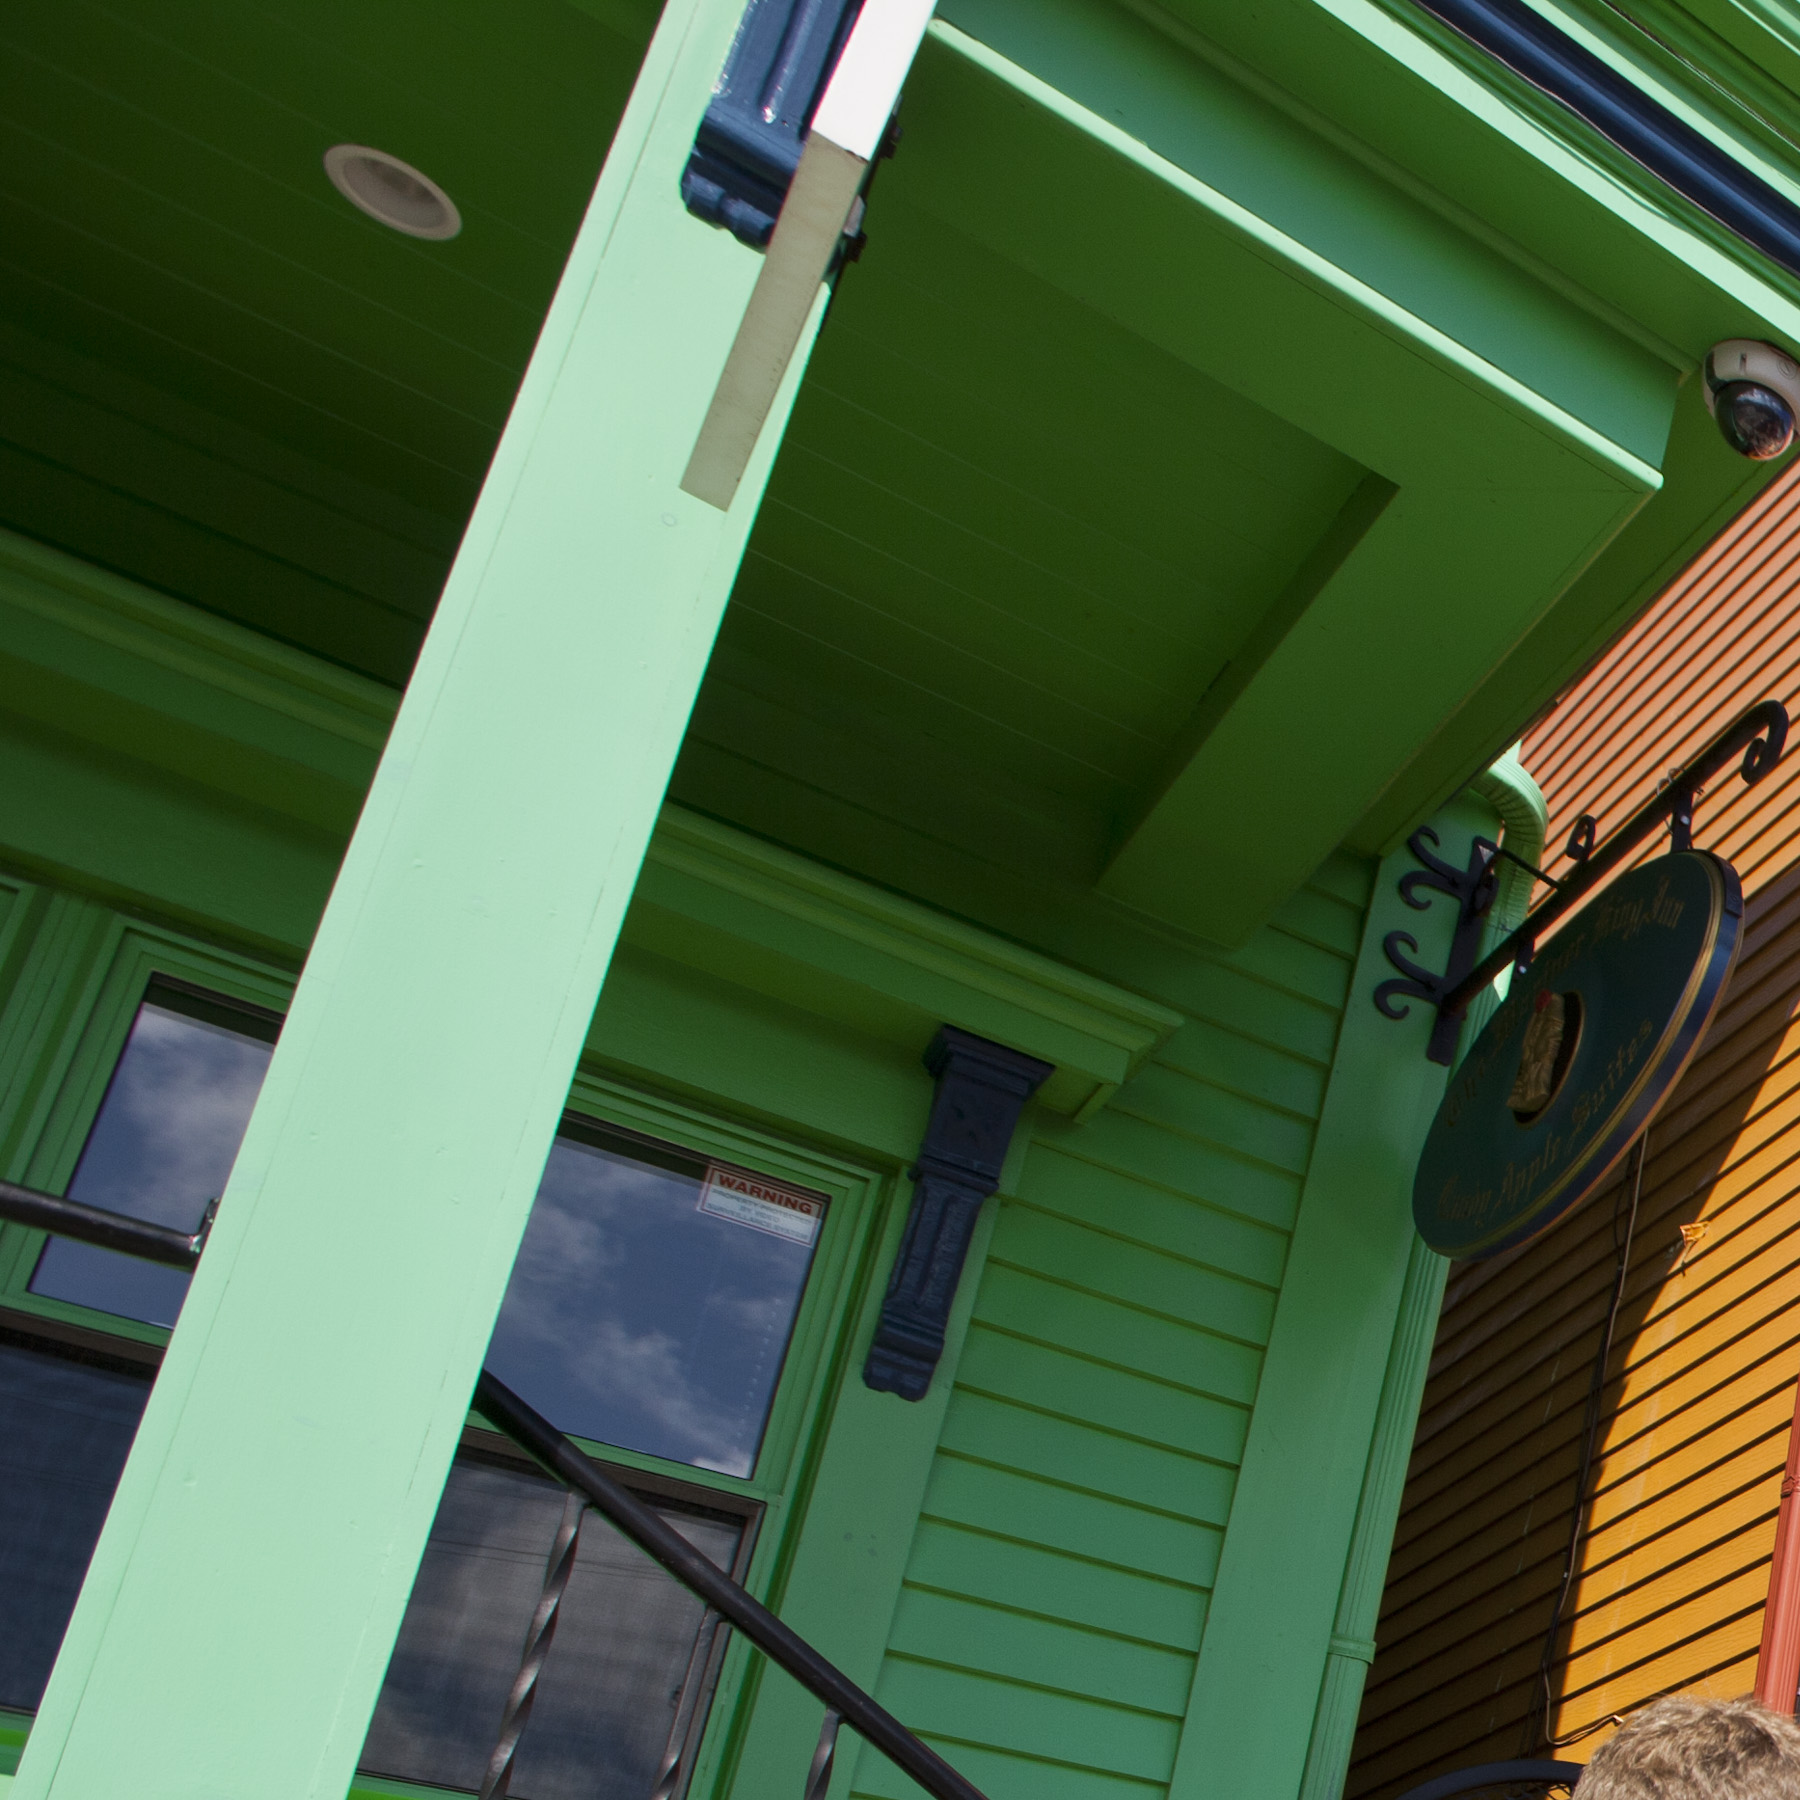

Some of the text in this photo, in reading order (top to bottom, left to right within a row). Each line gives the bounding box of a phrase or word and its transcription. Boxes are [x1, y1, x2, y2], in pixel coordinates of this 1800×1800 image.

[1590, 896, 1644, 951] King
[1641, 875, 1686, 929] Inn
[1490, 1132, 1561, 1219] Apple
[1566, 1019, 1653, 1155] Suites
[719, 1174, 812, 1214] WARNING
